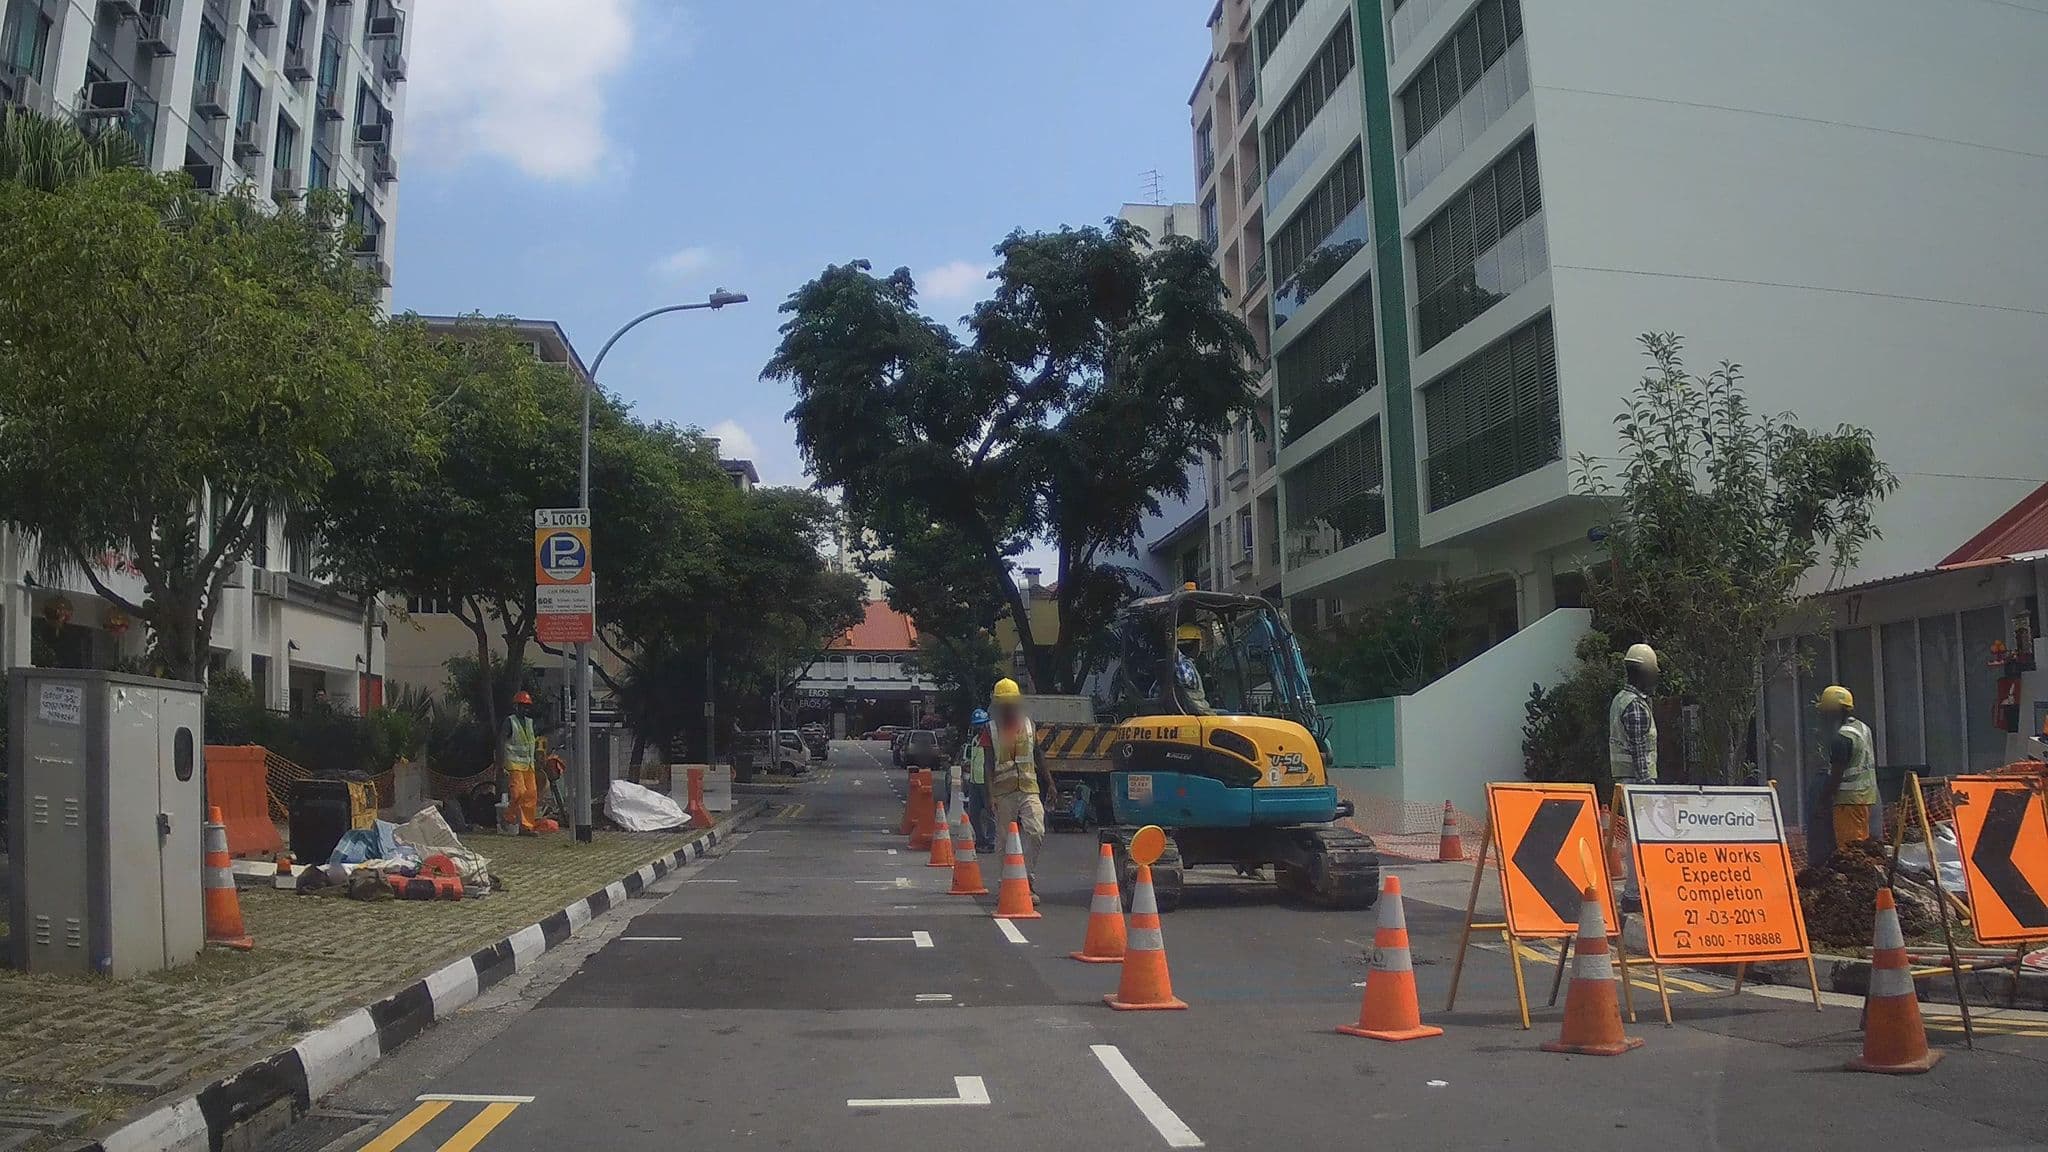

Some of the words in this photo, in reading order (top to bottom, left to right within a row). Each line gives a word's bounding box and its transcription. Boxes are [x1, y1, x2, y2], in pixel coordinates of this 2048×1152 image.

[552, 514, 587, 526] L0019
[550, 536, 580, 568] P
[808, 689, 830, 698] EROS
[1133, 727, 1152, 739] Pte
[1157, 727, 1179, 739] Ltd
[1678, 810, 1755, 826] PowerGrid
[1665, 848, 1708, 863] Cable
[1714, 848, 1761, 863] Works
[1682, 867, 1751, 885] Expected
[1677, 885, 1763, 904] Completion
[1699, 934, 1725, 947] 1800
[1735, 932, 1782, 946] 7788888
